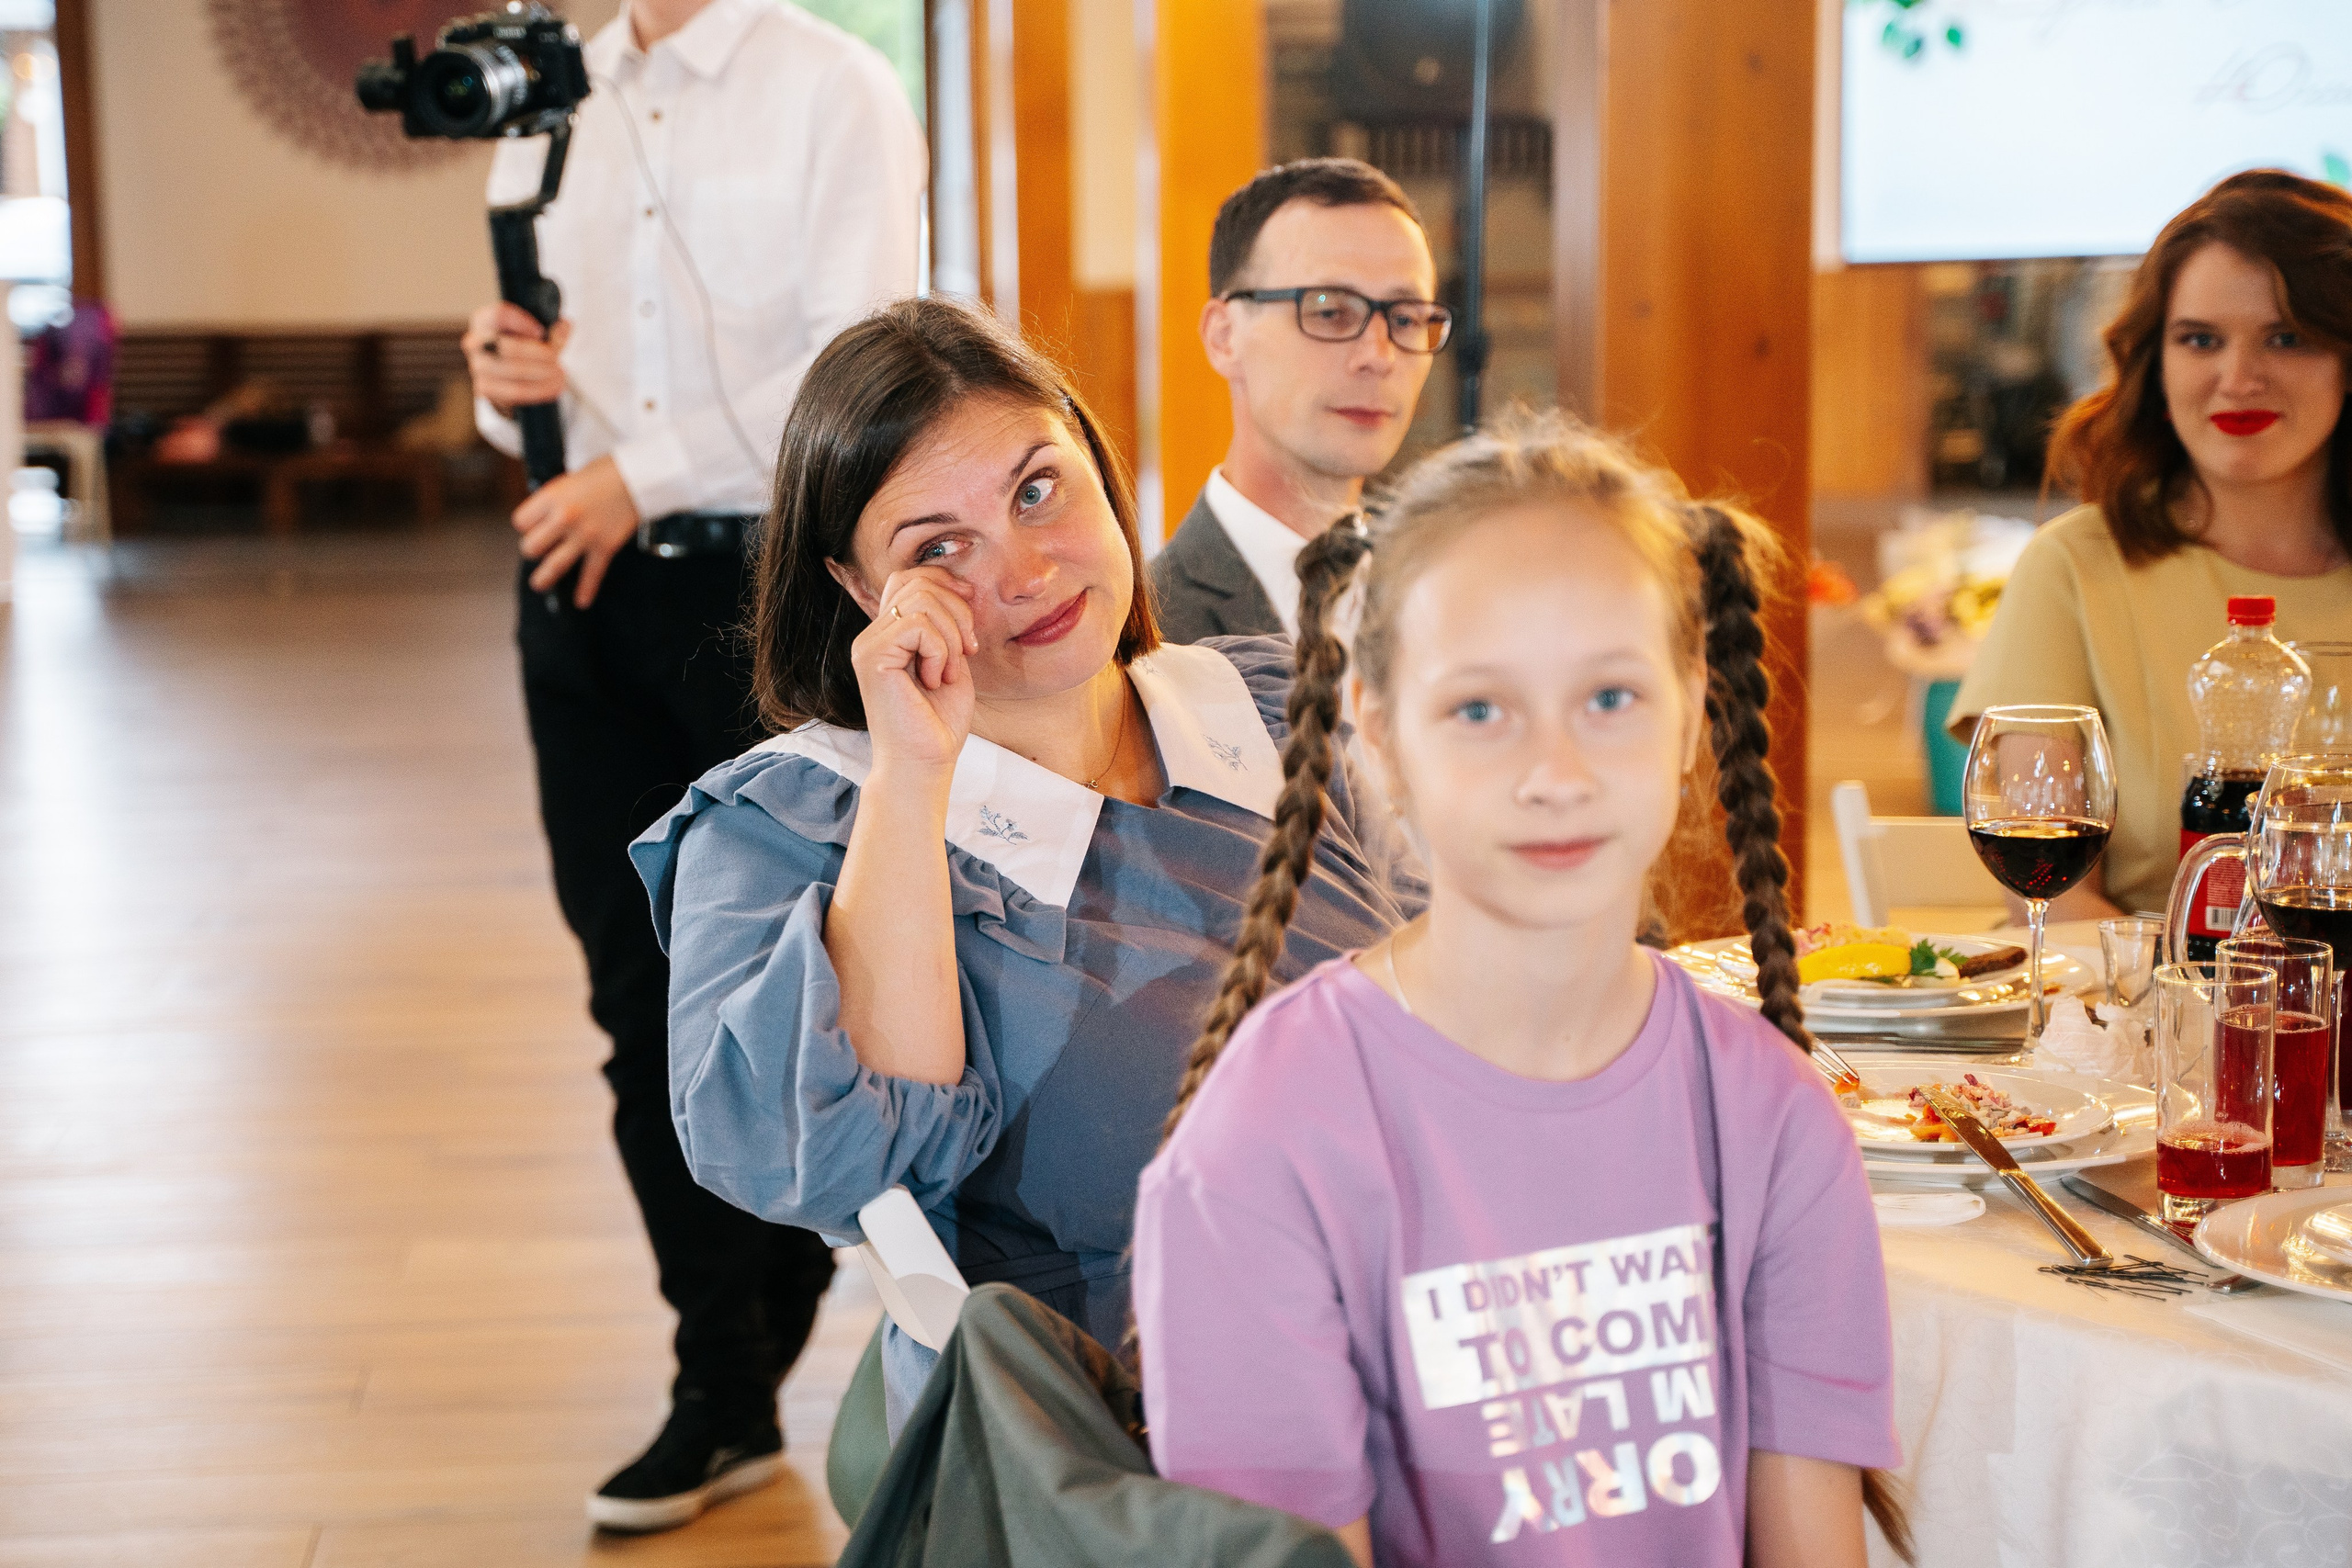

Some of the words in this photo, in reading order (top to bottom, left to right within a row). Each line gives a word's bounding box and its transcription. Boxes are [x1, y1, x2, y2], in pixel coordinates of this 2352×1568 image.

[1427, 1287, 1443, 1321] I
[1462, 1259, 1594, 1314] DIDN'T
[1457, 1326, 1532, 1382] TO
[1480, 1379, 1631, 1458] LATE
